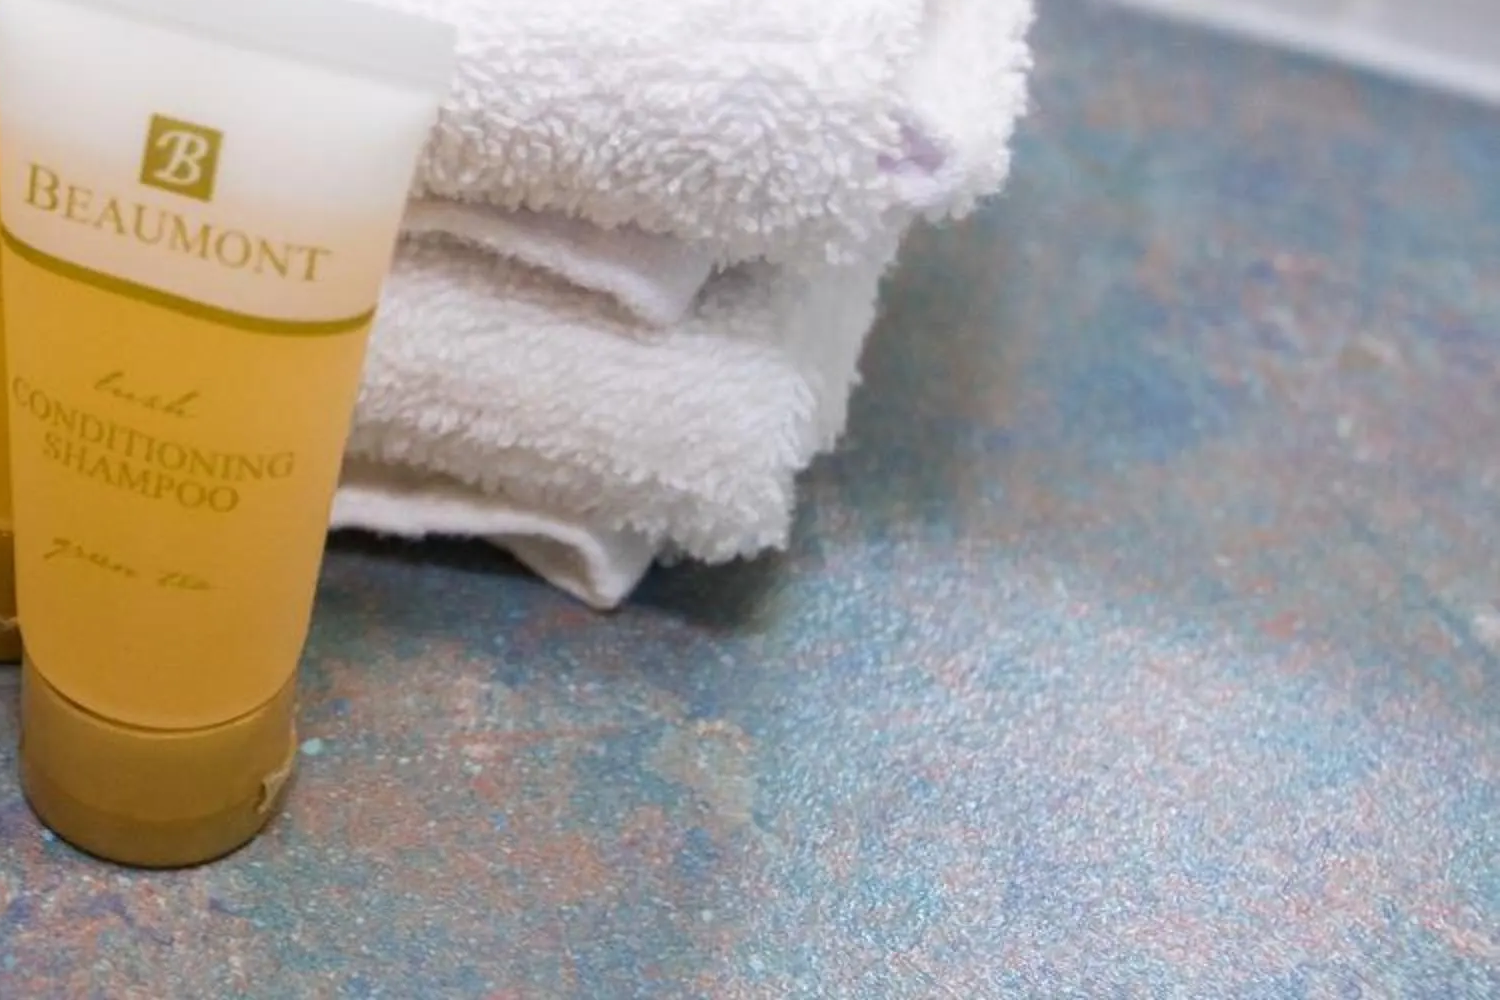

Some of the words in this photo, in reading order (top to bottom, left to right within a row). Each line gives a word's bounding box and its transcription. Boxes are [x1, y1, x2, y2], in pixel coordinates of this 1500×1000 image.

[150, 126, 212, 189] B
[25, 161, 332, 283] BEAUMONT
[11, 376, 295, 482] CONDITIONING
[43, 430, 240, 513] SHAMPOO
